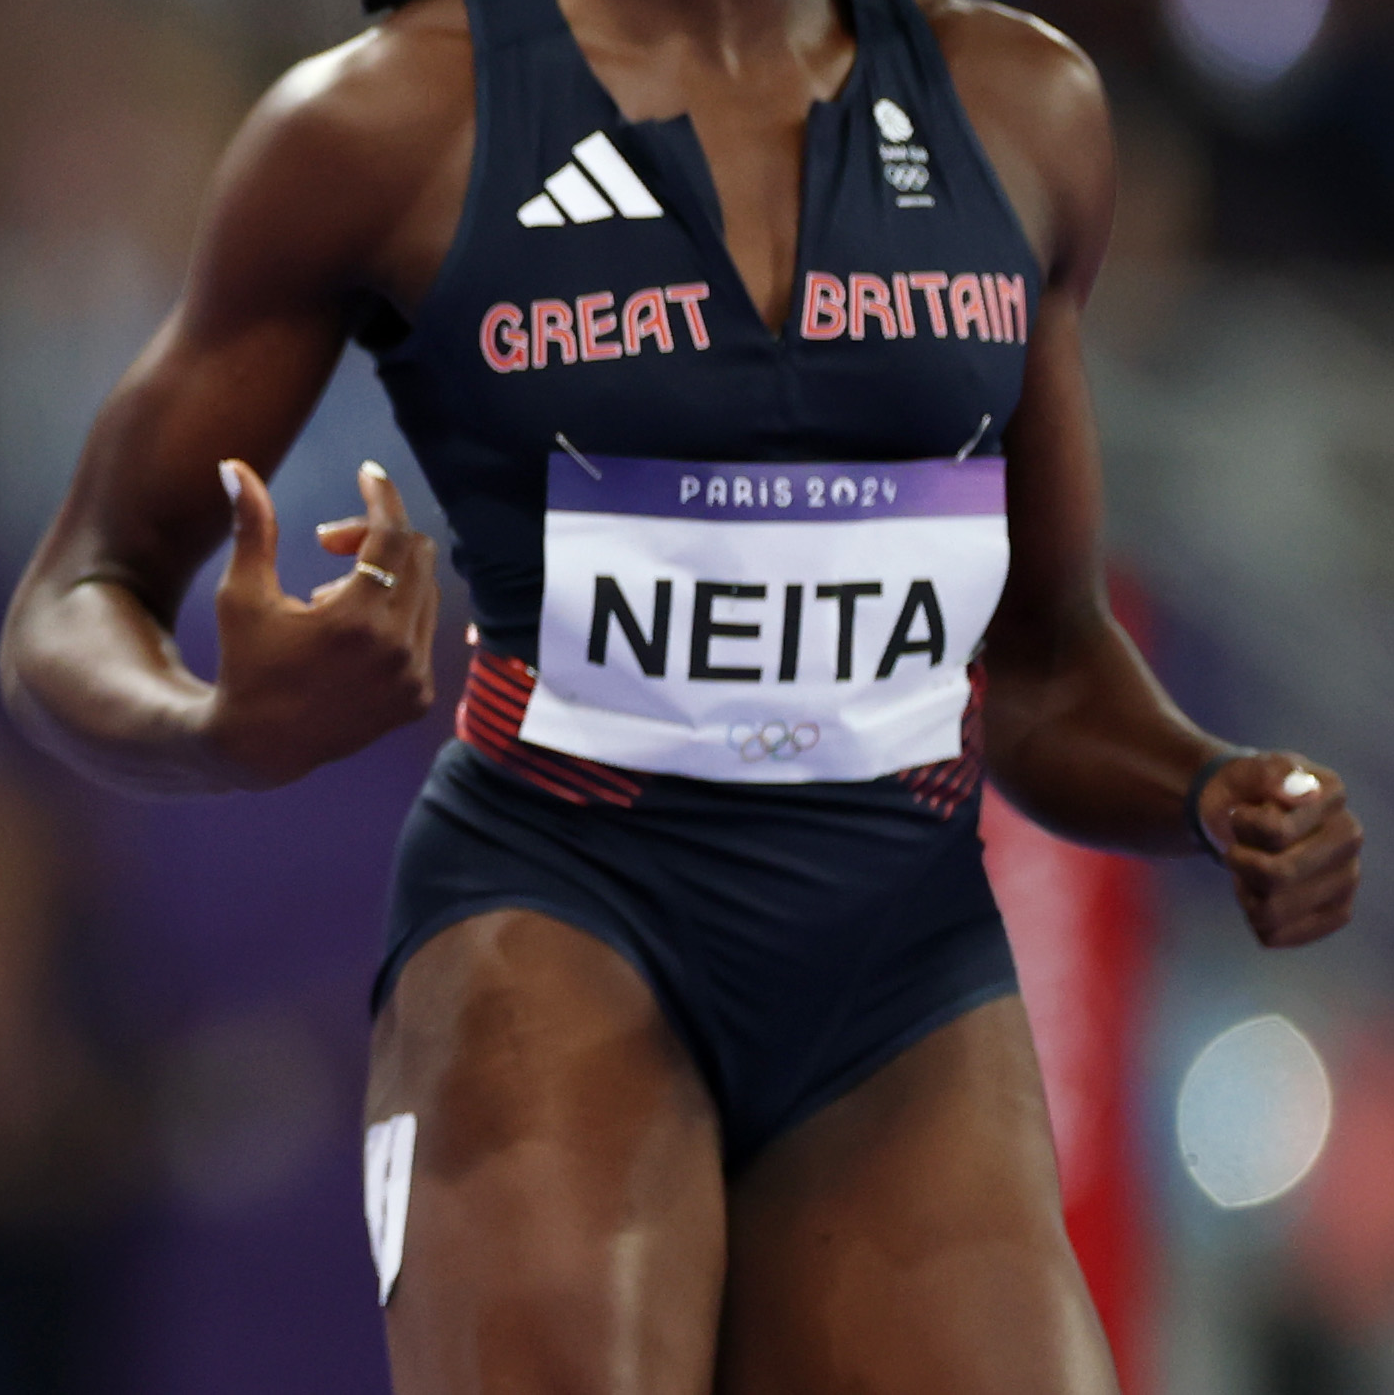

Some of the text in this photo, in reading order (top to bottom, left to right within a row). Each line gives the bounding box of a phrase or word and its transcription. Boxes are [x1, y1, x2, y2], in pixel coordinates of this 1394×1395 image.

[479, 271, 1028, 373] GREAT BRITAIN
[805, 475, 898, 508] 2024
[587, 576, 949, 683] NEITA
